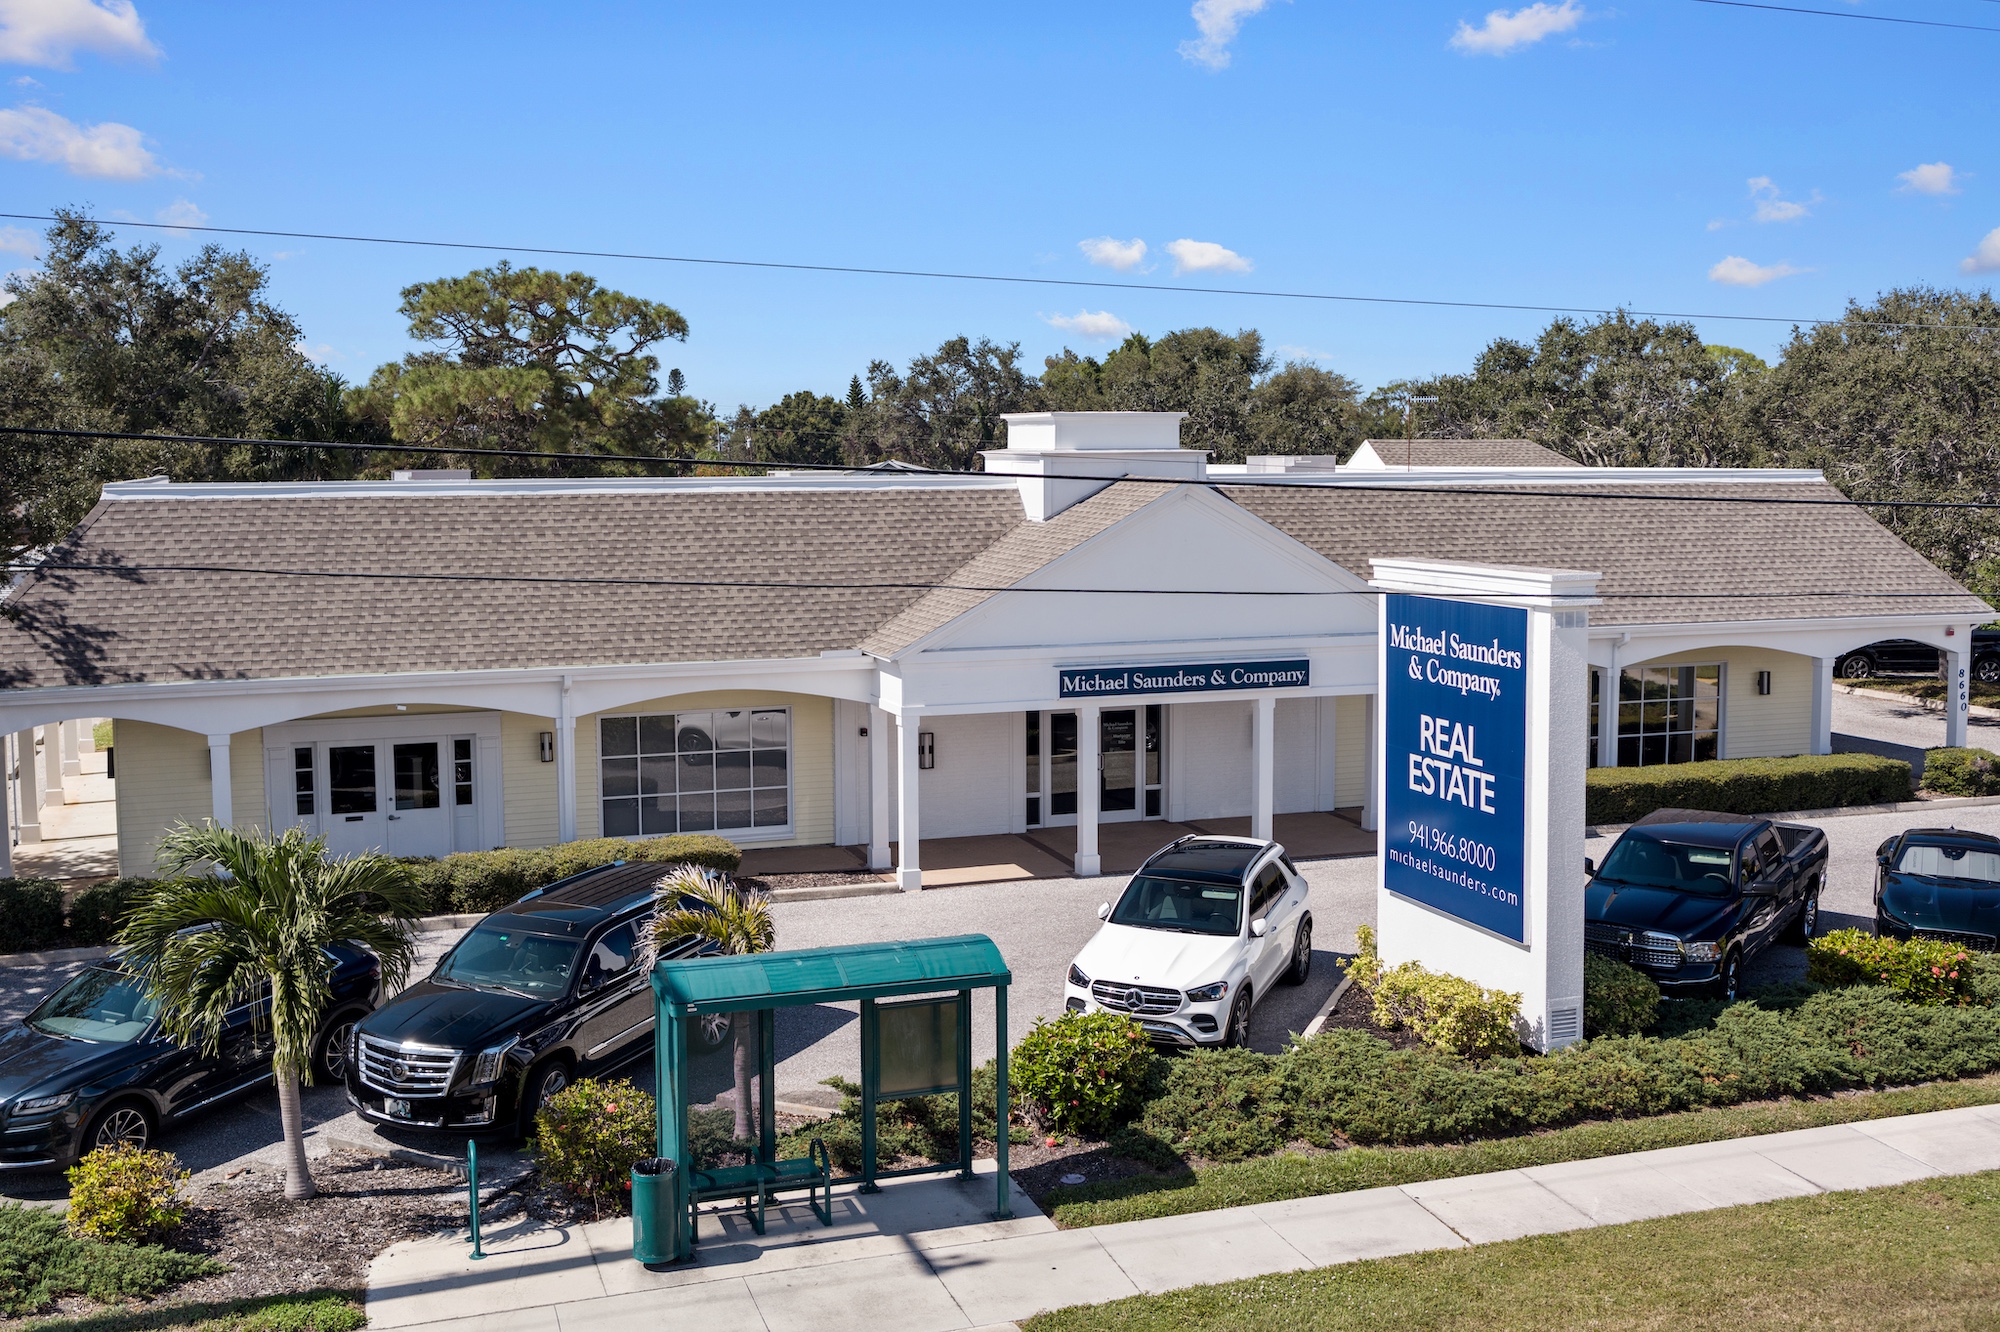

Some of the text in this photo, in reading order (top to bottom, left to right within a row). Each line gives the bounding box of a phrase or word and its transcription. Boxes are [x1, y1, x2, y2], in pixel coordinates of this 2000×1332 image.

[1390, 623, 1522, 671] Michael Saunders
[1408, 655, 1424, 681] &
[1062, 668, 1306, 693] Michael Saunders & Company
[1419, 713, 1484, 768] REAL
[1408, 752, 1496, 815] ESTATE
[1408, 820, 1496, 873] 941.966.8000
[1389, 847, 1519, 907] michaelsaunders.com
